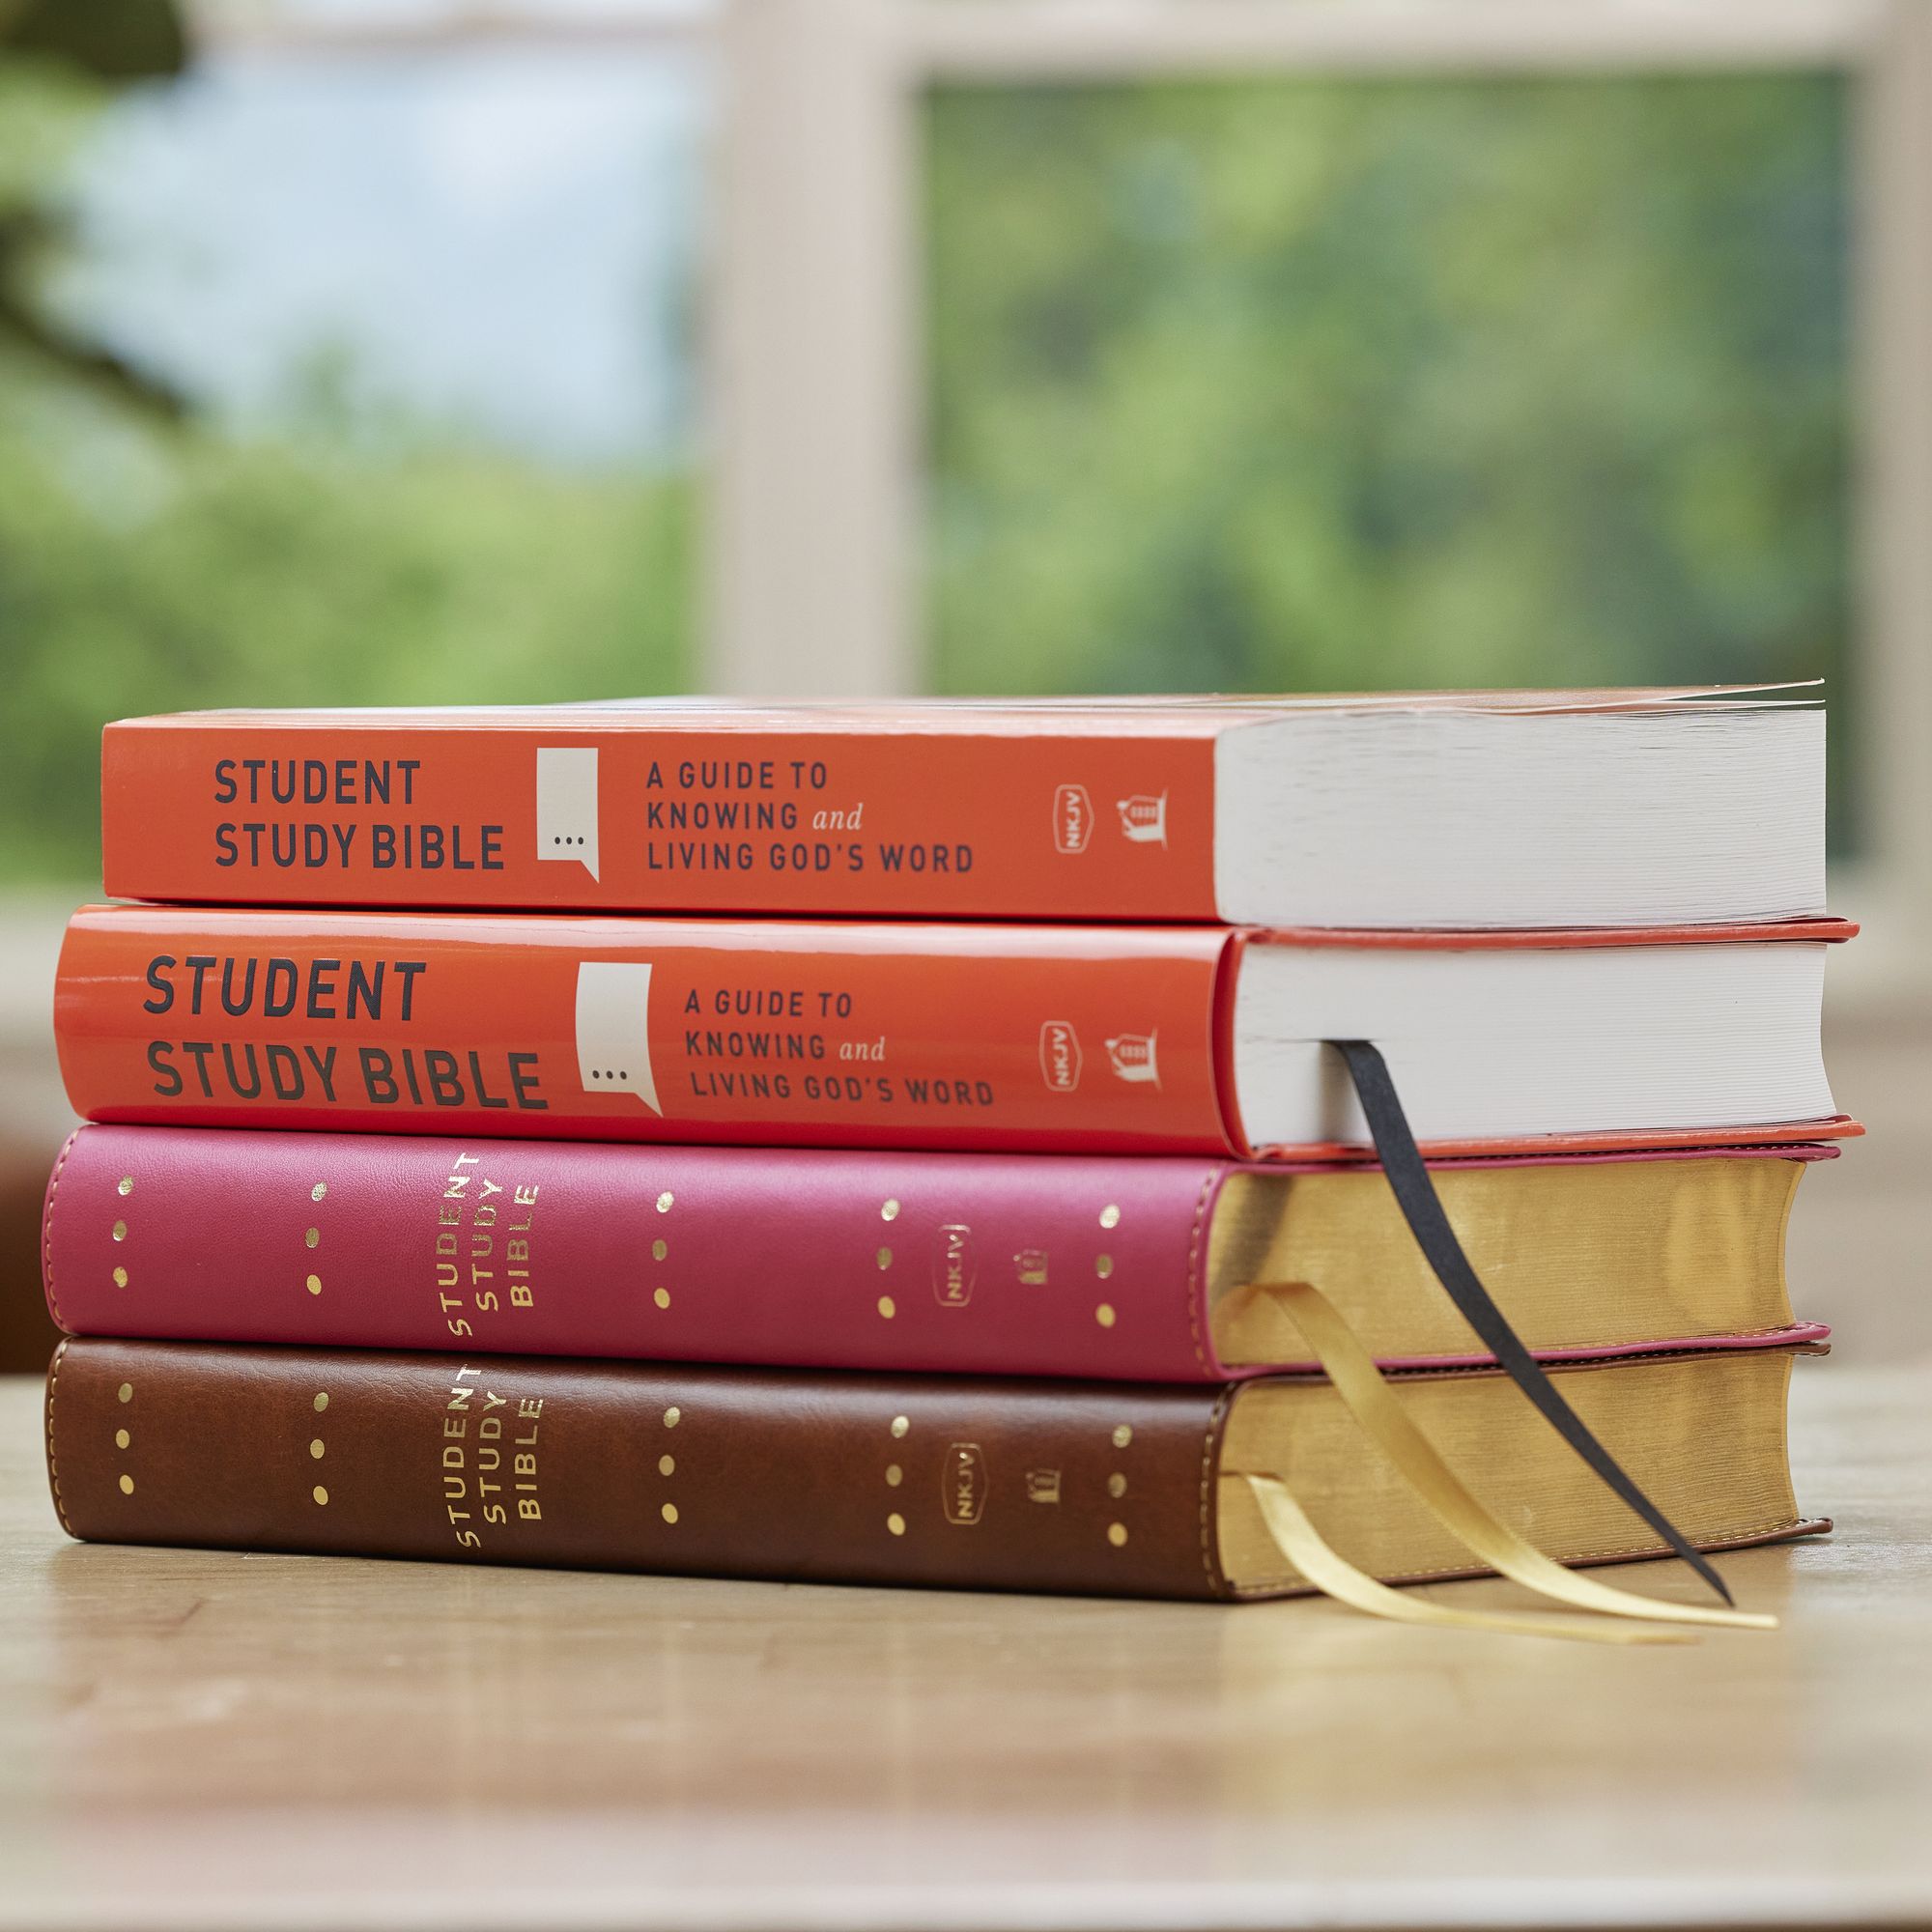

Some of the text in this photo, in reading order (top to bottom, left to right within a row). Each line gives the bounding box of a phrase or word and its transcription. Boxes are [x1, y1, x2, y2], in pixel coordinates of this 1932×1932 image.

[214, 759, 421, 805] STUDENT
[646, 761, 827, 789] A GUIDE TO
[214, 823, 504, 869] STUDY BIBLE
[647, 802, 864, 831] KNOWING and
[1065, 791, 1082, 849] NKJV
[648, 842, 974, 873] LIVING GOD'S WORD
[143, 955, 427, 1021] STUDENT
[684, 989, 853, 1018] A GUIDE TO
[147, 1040, 550, 1110] STUDY BIBLE
[685, 1031, 886, 1063] KNOWING and
[1053, 1027, 1070, 1086] NKJV
[691, 1072, 994, 1106] LIVING GOD'S WORD
[436, 1152, 480, 1337] STUDENT
[470, 1178, 503, 1312] STUDY
[507, 1184, 539, 1308] BIBLE
[948, 1234, 964, 1299] NKJV
[442, 1363, 482, 1548] STUDENT
[479, 1390, 507, 1524] STUDY
[515, 1398, 544, 1520] BIBLE
[958, 1452, 975, 1518] NKJV
